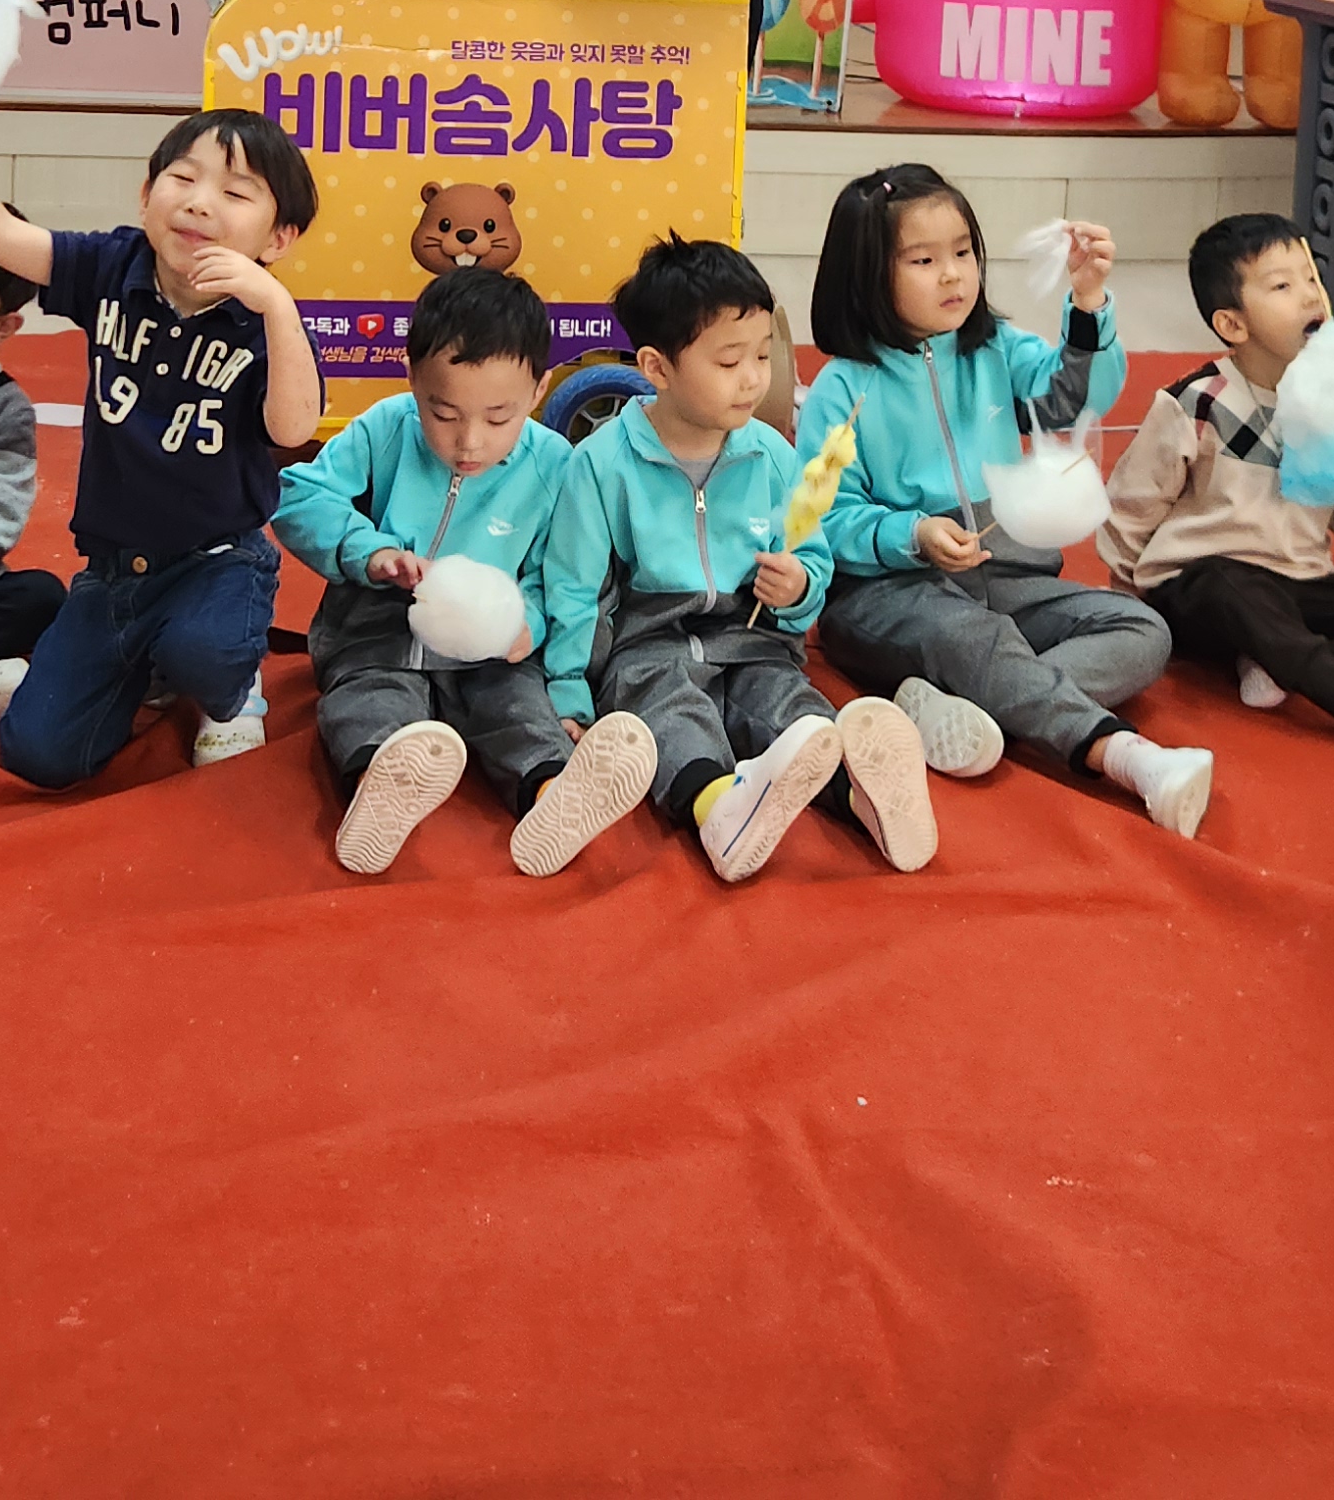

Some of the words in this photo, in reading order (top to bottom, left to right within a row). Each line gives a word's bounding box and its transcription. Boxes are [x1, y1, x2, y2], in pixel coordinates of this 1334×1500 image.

[451, 40, 506, 61] 달콤한
[511, 41, 565, 62] 웃음과
[570, 43, 606, 63] 잊지
[610, 44, 646, 65] 못할
[650, 44, 690, 65] 추억!
[940, 2, 1115, 88] MINE
[264, 70, 683, 160] 비버솜사탕
[559, 319, 612, 338] 됩니다!
